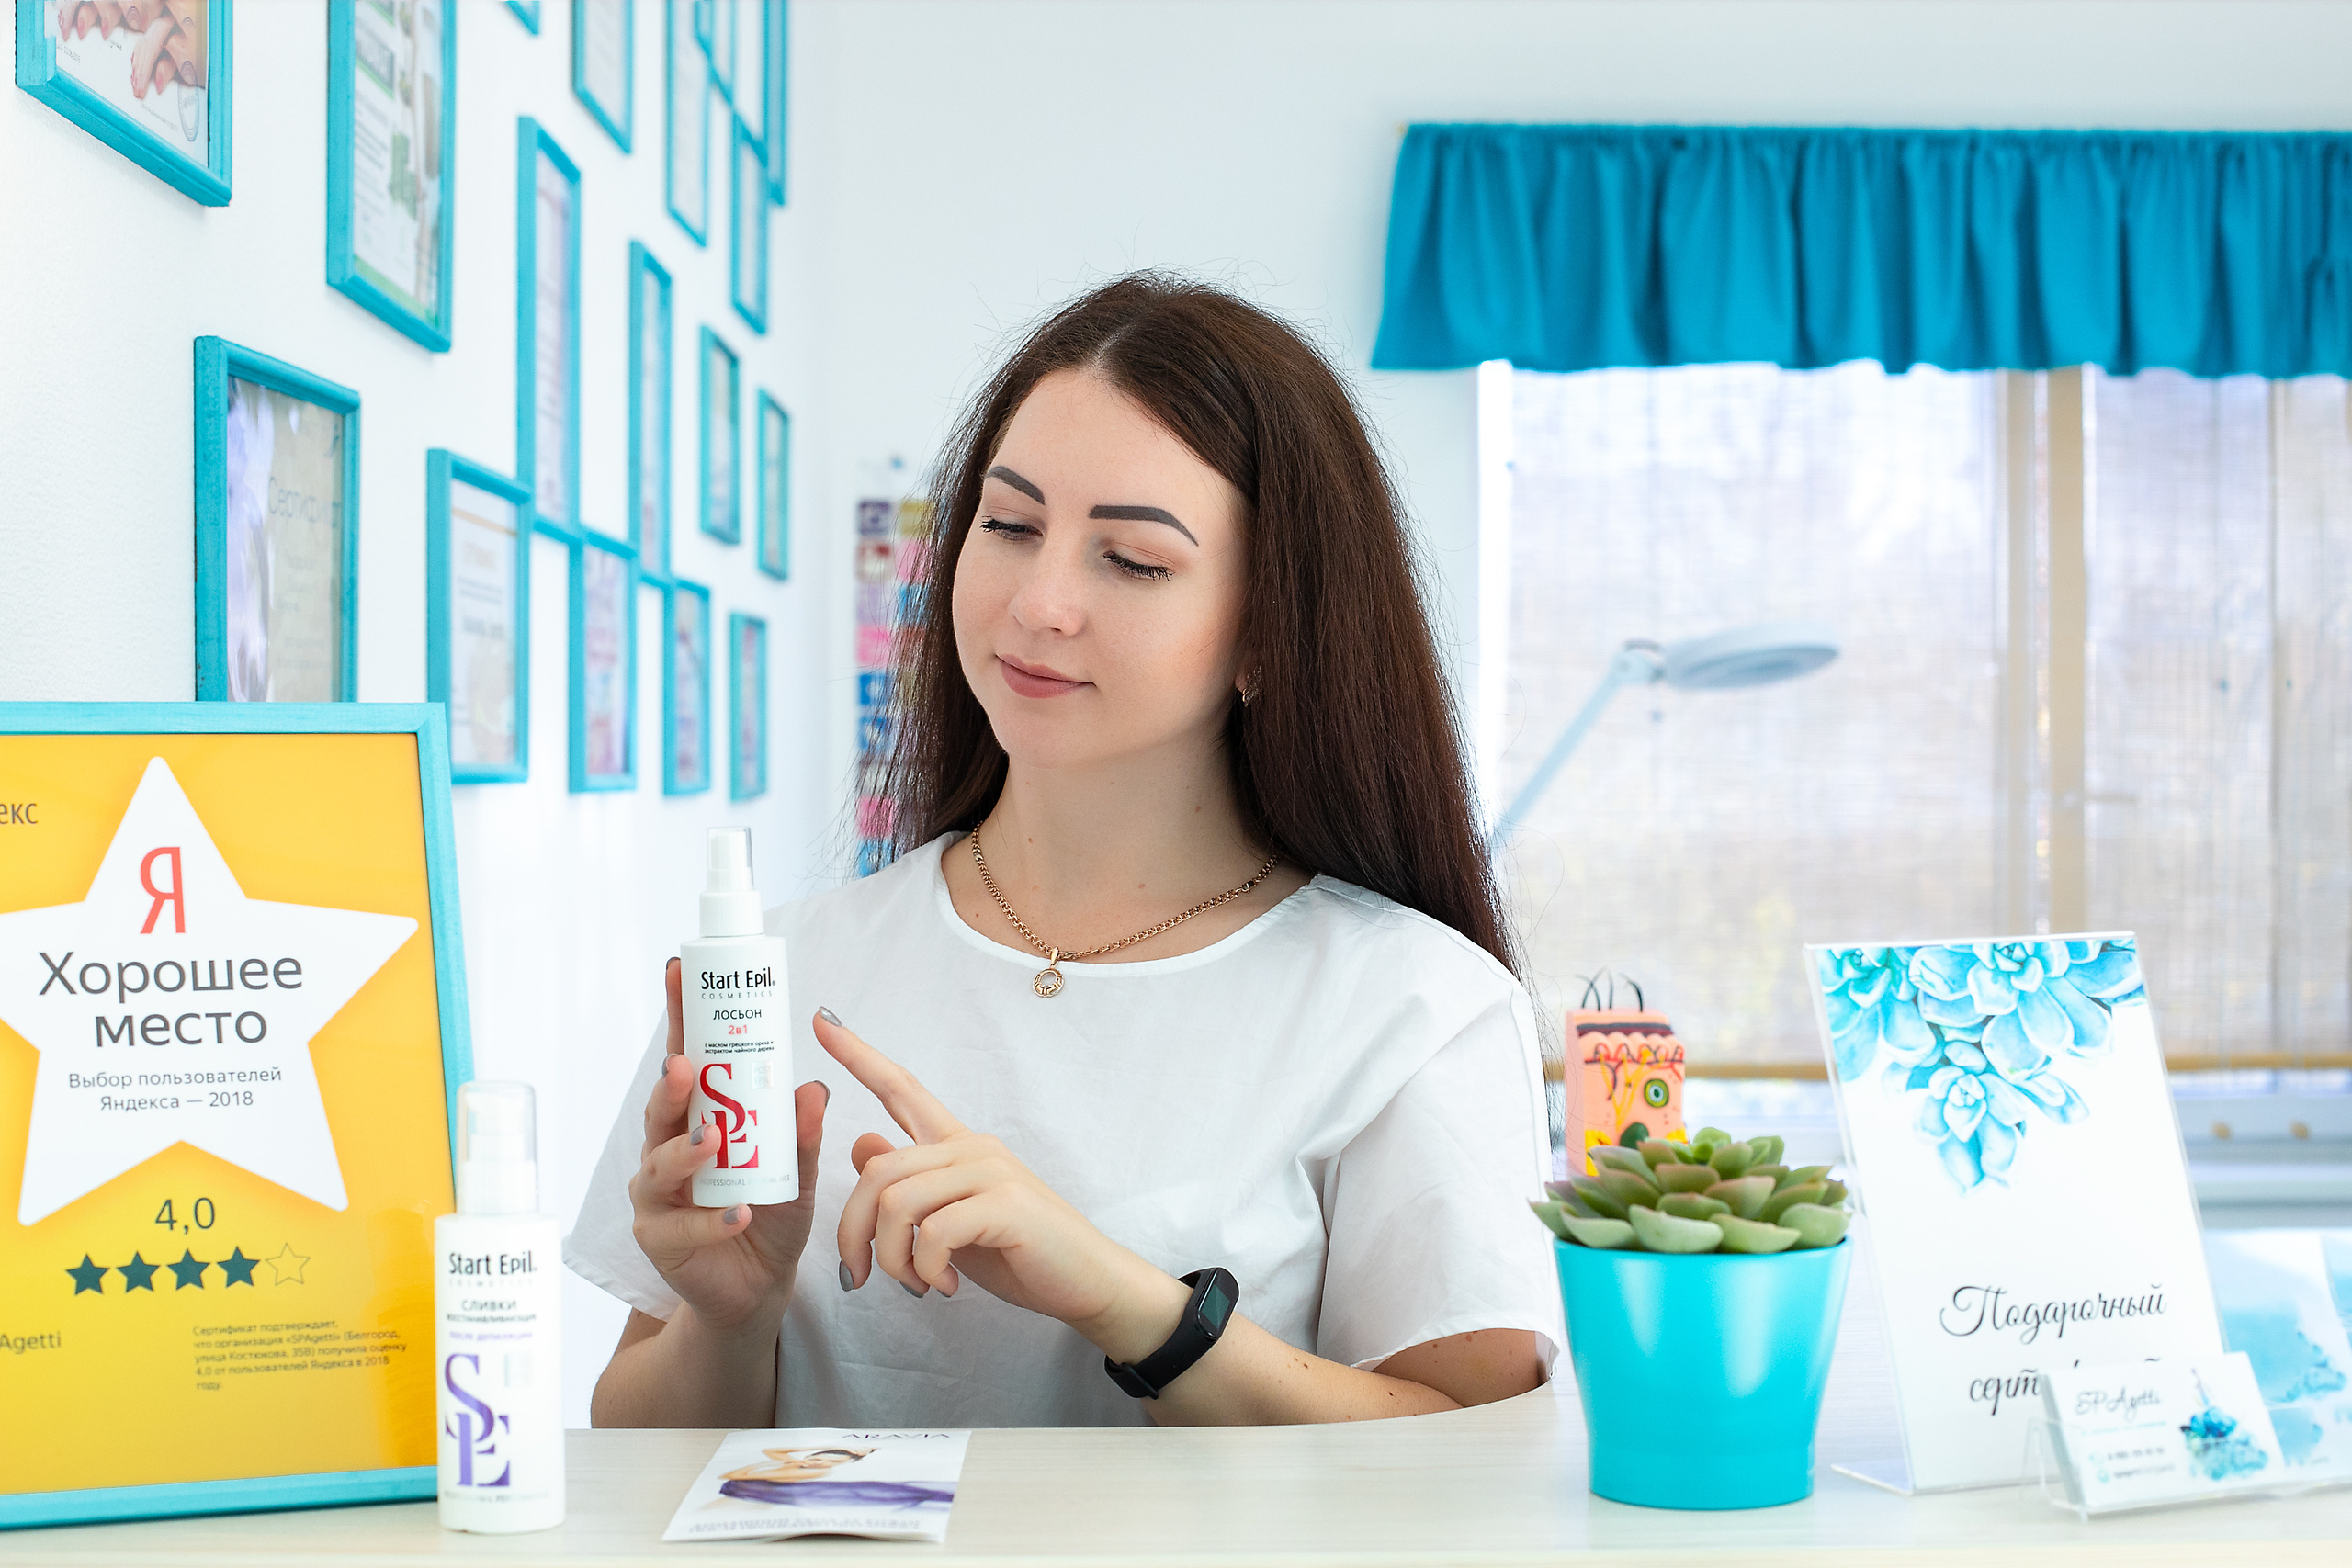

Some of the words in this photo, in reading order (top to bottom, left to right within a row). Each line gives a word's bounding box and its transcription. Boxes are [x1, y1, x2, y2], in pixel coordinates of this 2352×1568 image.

[140, 846, 186, 934] Я
[39, 951, 303, 1004] Хорошее
[701, 970, 740, 989] Start
[701, 990, 773, 999] COSMETICS
[713, 1009, 762, 1020] ЛОСЬОН
[95, 1010, 267, 1047] место
[729, 1024, 747, 1034] 2в1
[729, 1041, 753, 1050] грецкого
[68, 1071, 133, 1090] Выбор
[138, 1066, 282, 1087] пользователей
[100, 1095, 180, 1112] Яндекса
[209, 1090, 254, 1108] 2018
[700, 1179, 746, 1187] PROFESSIONAL
[155, 1197, 216, 1235] 4,0
[448, 1252, 492, 1275] Start
[1939, 1283, 2167, 1344] Подарочный
[192, 1325, 257, 1337] Сертификат
[194, 1339, 212, 1349] что
[214, 1337, 283, 1349] организация
[286, 1332, 340, 1345] «SPAgetti»
[195, 1354, 227, 1364] улица
[318, 1346, 367, 1357] получила
[369, 1343, 407, 1353] оценку
[214, 1368, 226, 1376] от
[229, 1362, 308, 1375] пользователей
[311, 1359, 354, 1371] Яндекса
[365, 1355, 390, 1366] 2018
